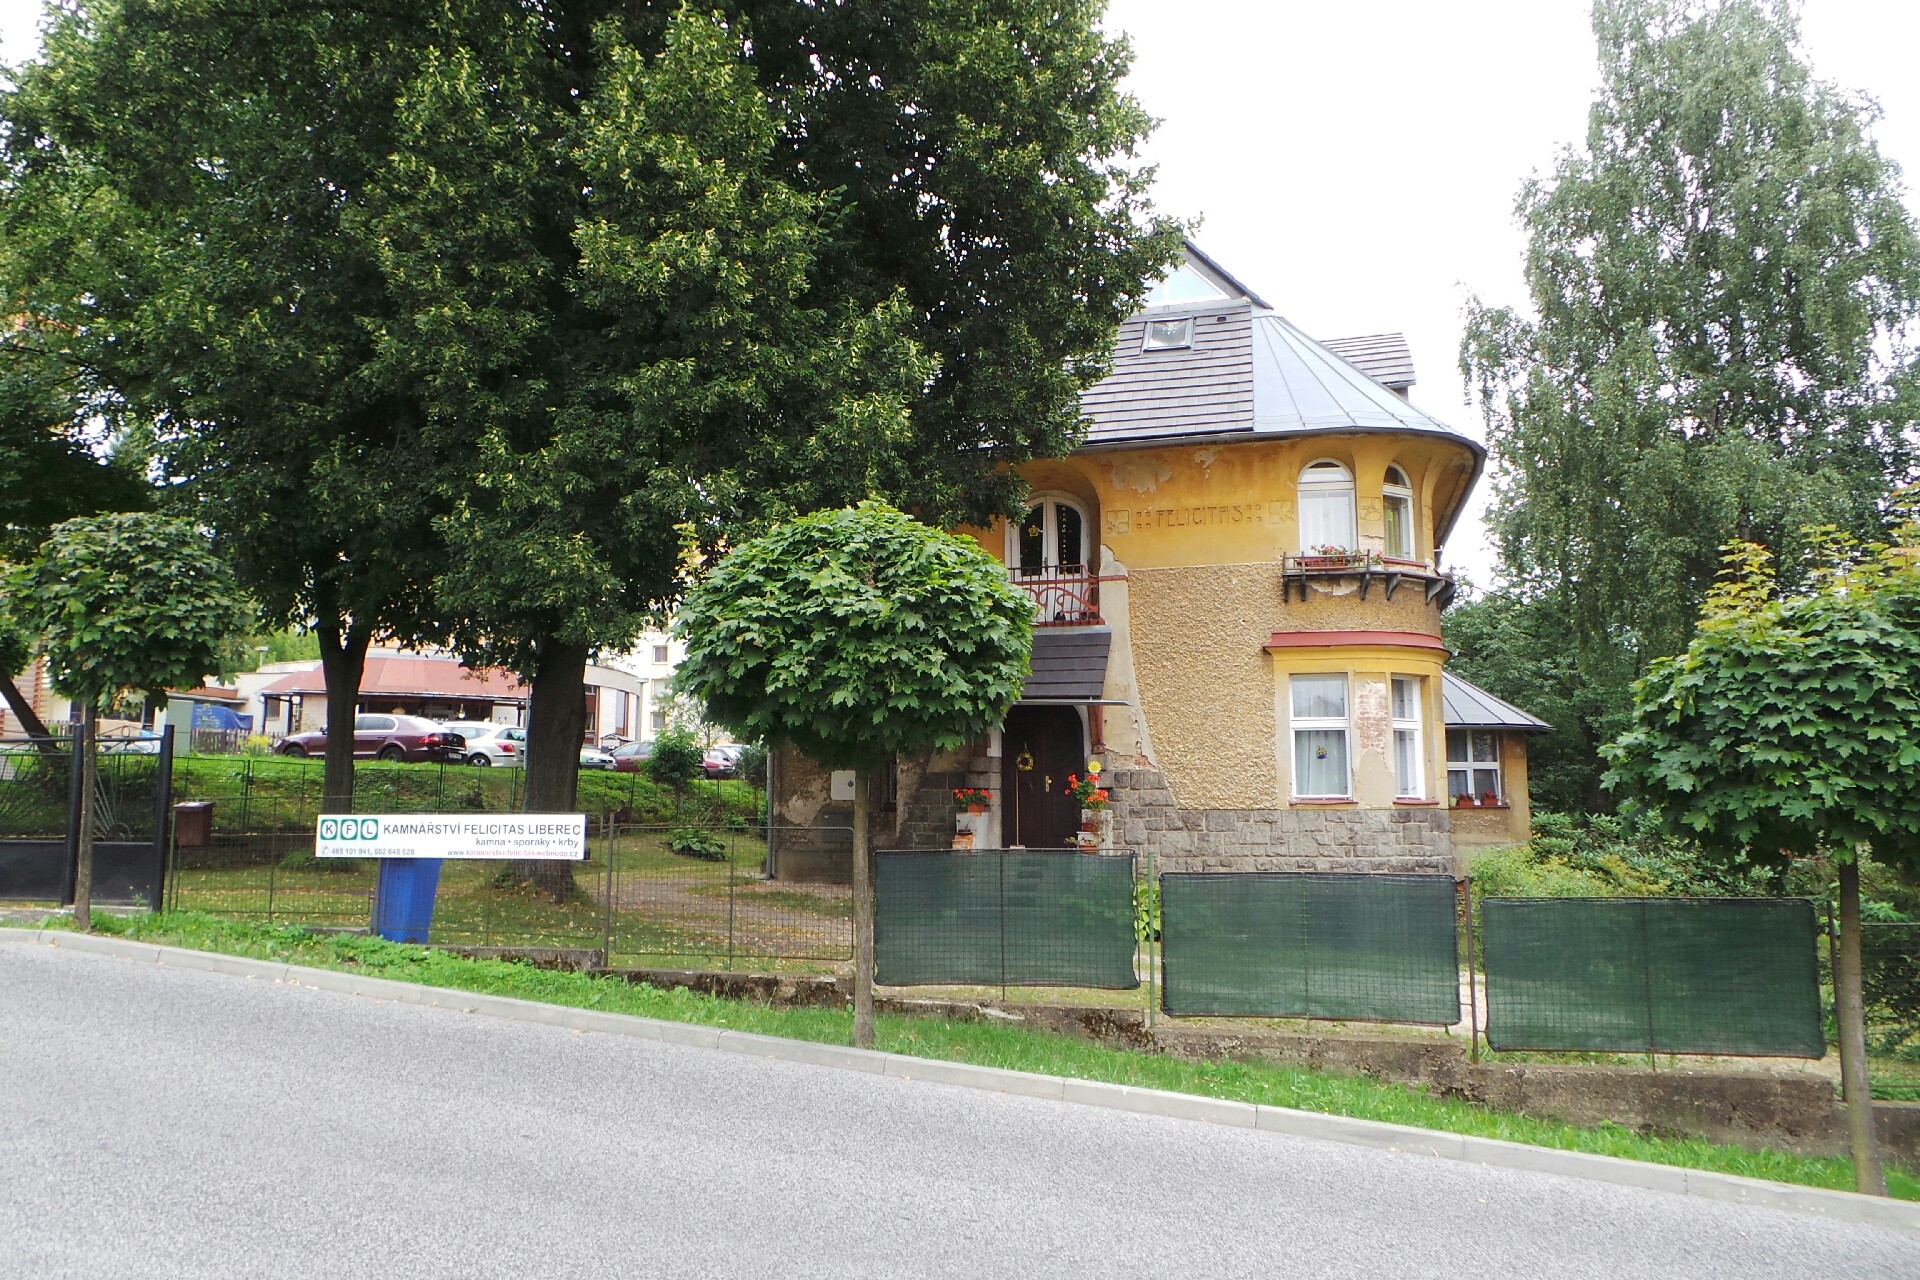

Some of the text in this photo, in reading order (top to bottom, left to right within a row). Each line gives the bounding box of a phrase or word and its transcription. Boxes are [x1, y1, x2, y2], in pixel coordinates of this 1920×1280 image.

[1156, 505, 1243, 527] FELICITAS
[383, 822, 581, 835] KAMNÁŘSTVÍ FELICITAS LIBEREC
[476, 838, 506, 846] kamna
[558, 838, 579, 848] krby
[345, 847, 357, 855] 101
